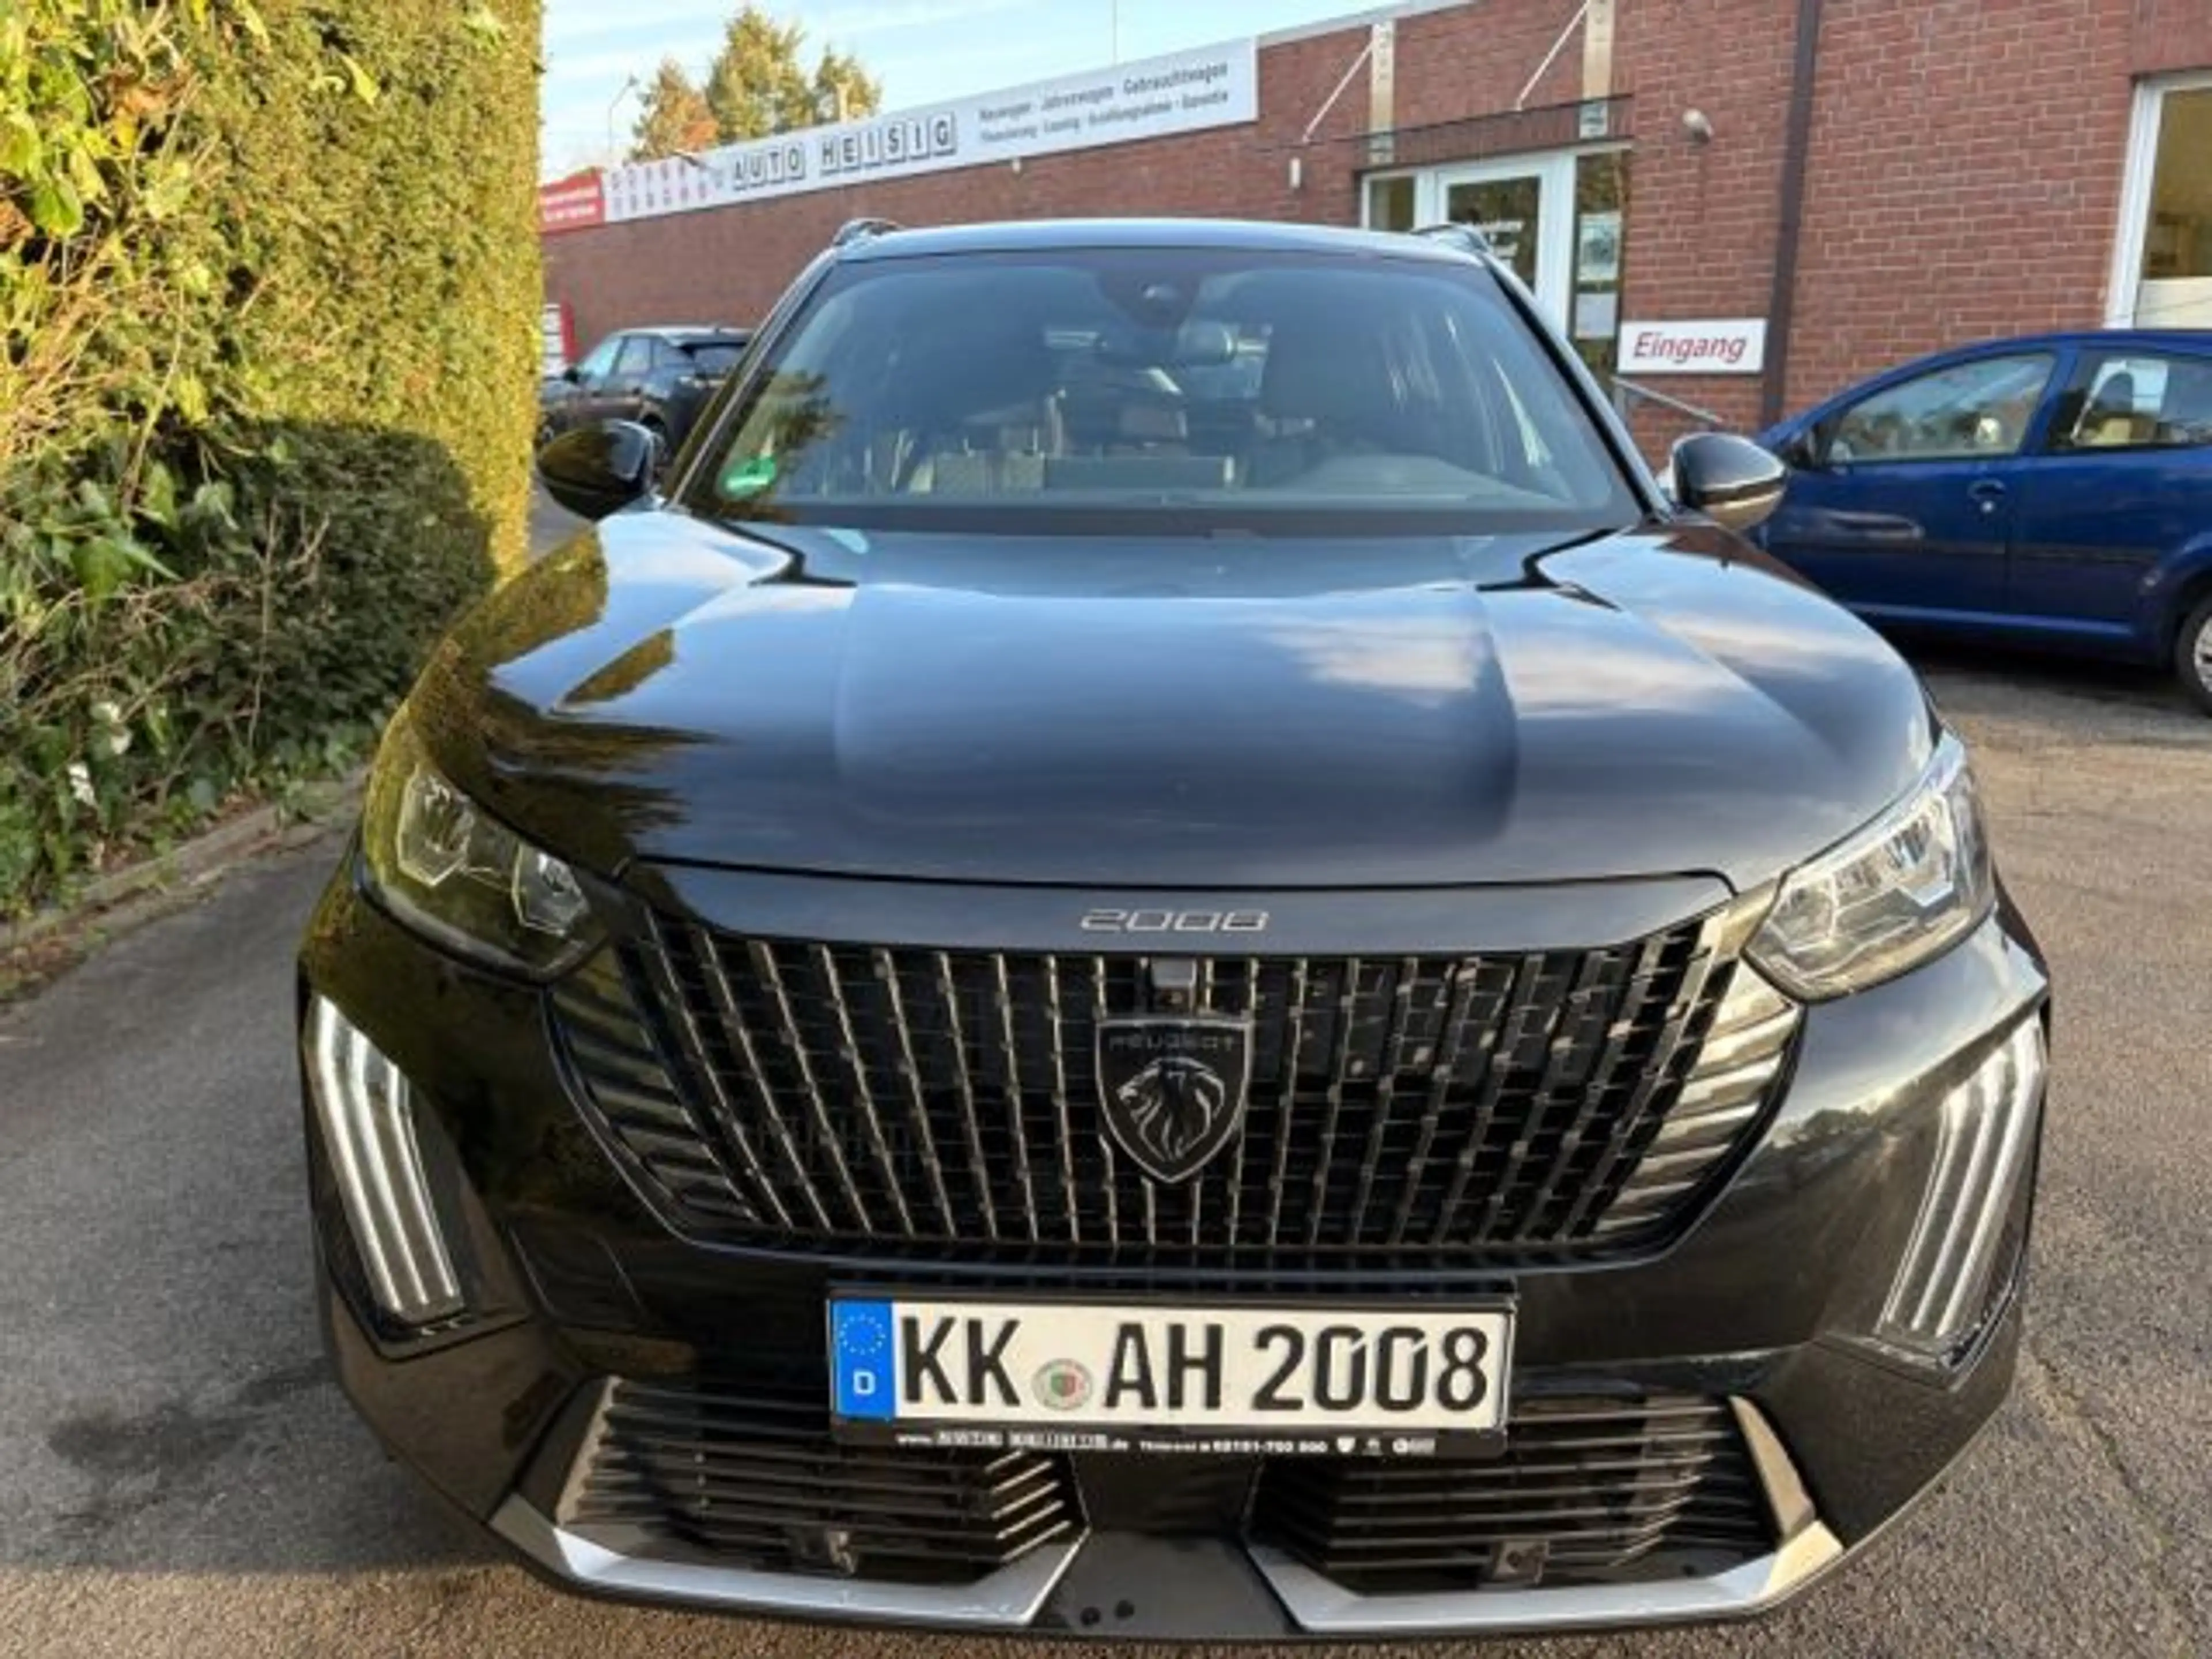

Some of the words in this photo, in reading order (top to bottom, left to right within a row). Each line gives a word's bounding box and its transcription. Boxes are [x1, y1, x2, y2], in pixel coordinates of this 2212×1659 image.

[734, 145, 803, 184] AUTO
[821, 118, 950, 170] HEISIG
[1633, 331, 1747, 365] Eingang
[1080, 908, 1268, 931] 2008
[899, 1316, 1022, 1406] KK
[1105, 1321, 1222, 1411] AH
[1252, 1325, 1489, 1412] 2008
[853, 1371, 874, 1395] D
